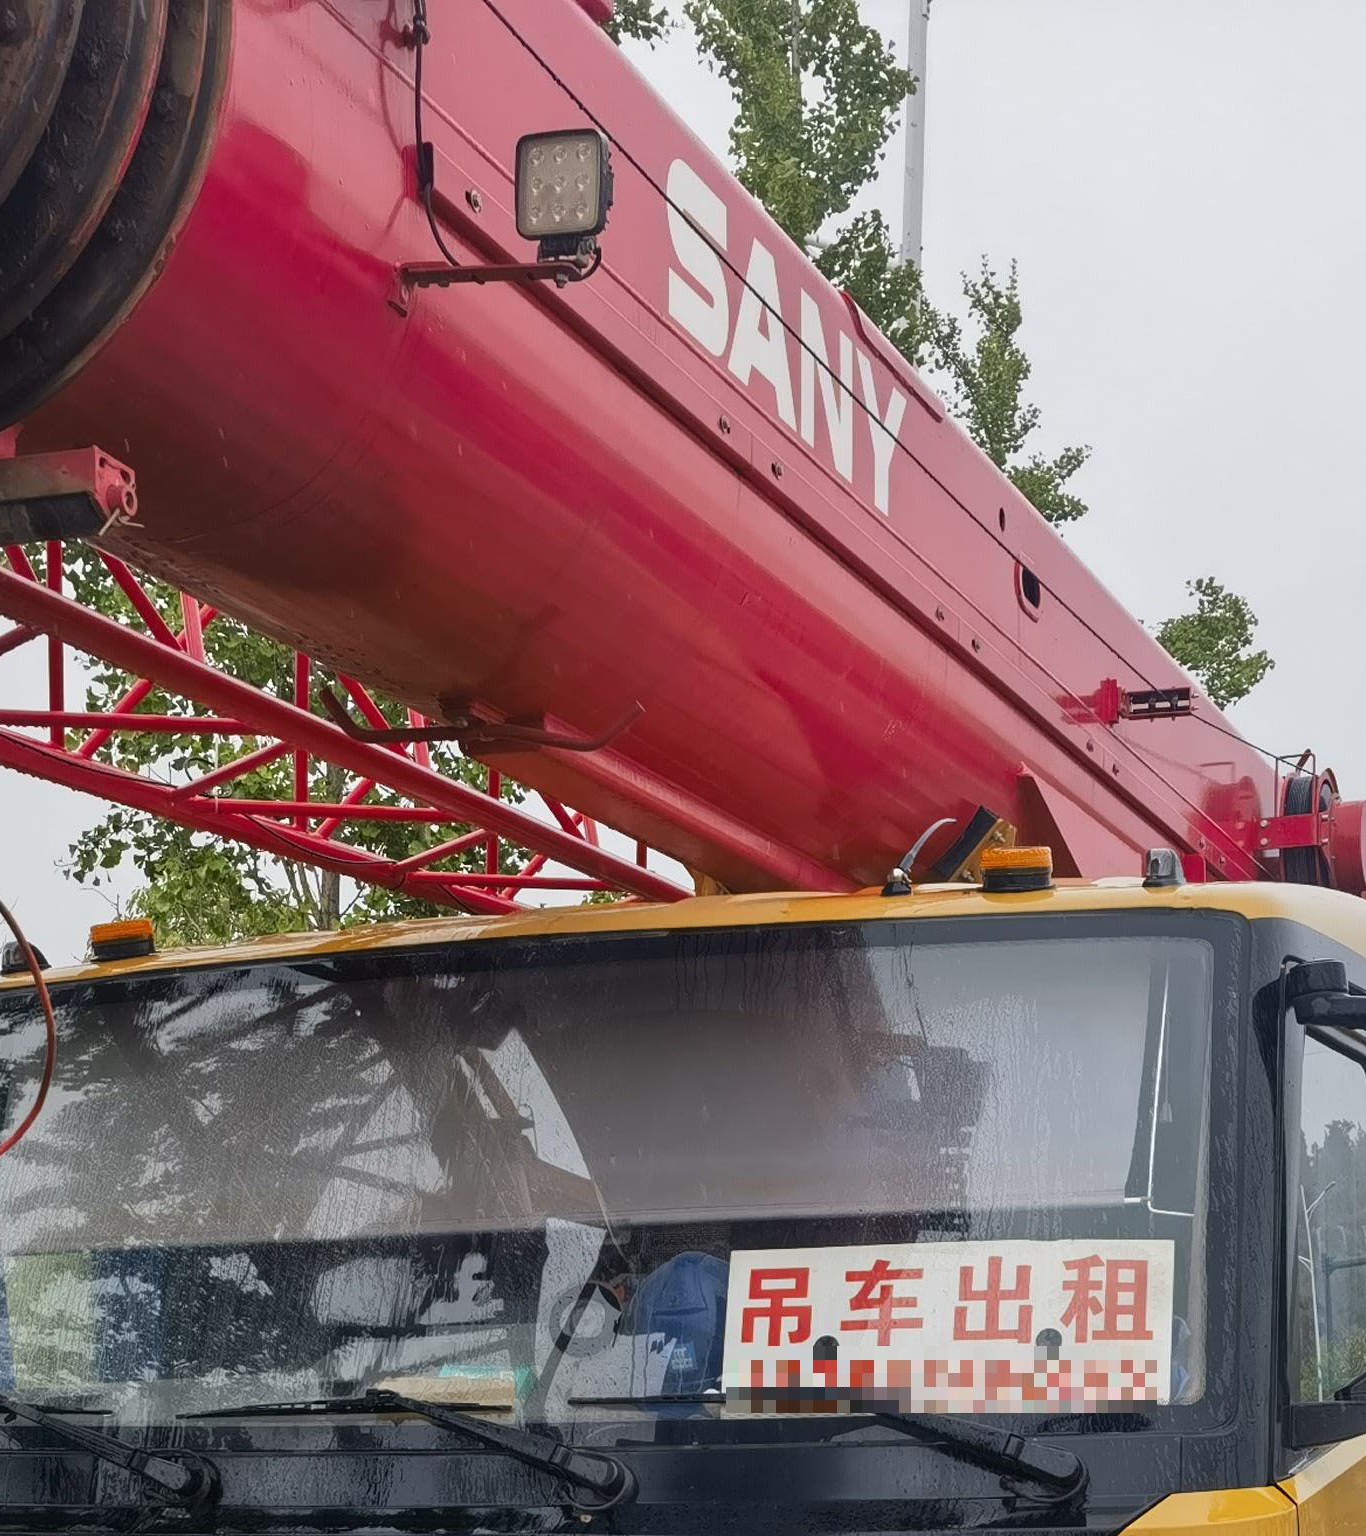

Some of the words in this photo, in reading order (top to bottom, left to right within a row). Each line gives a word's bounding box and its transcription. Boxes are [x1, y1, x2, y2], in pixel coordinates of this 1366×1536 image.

[666, 158, 906, 517] SANY
[740, 1253, 1154, 1347] 吊车出租
